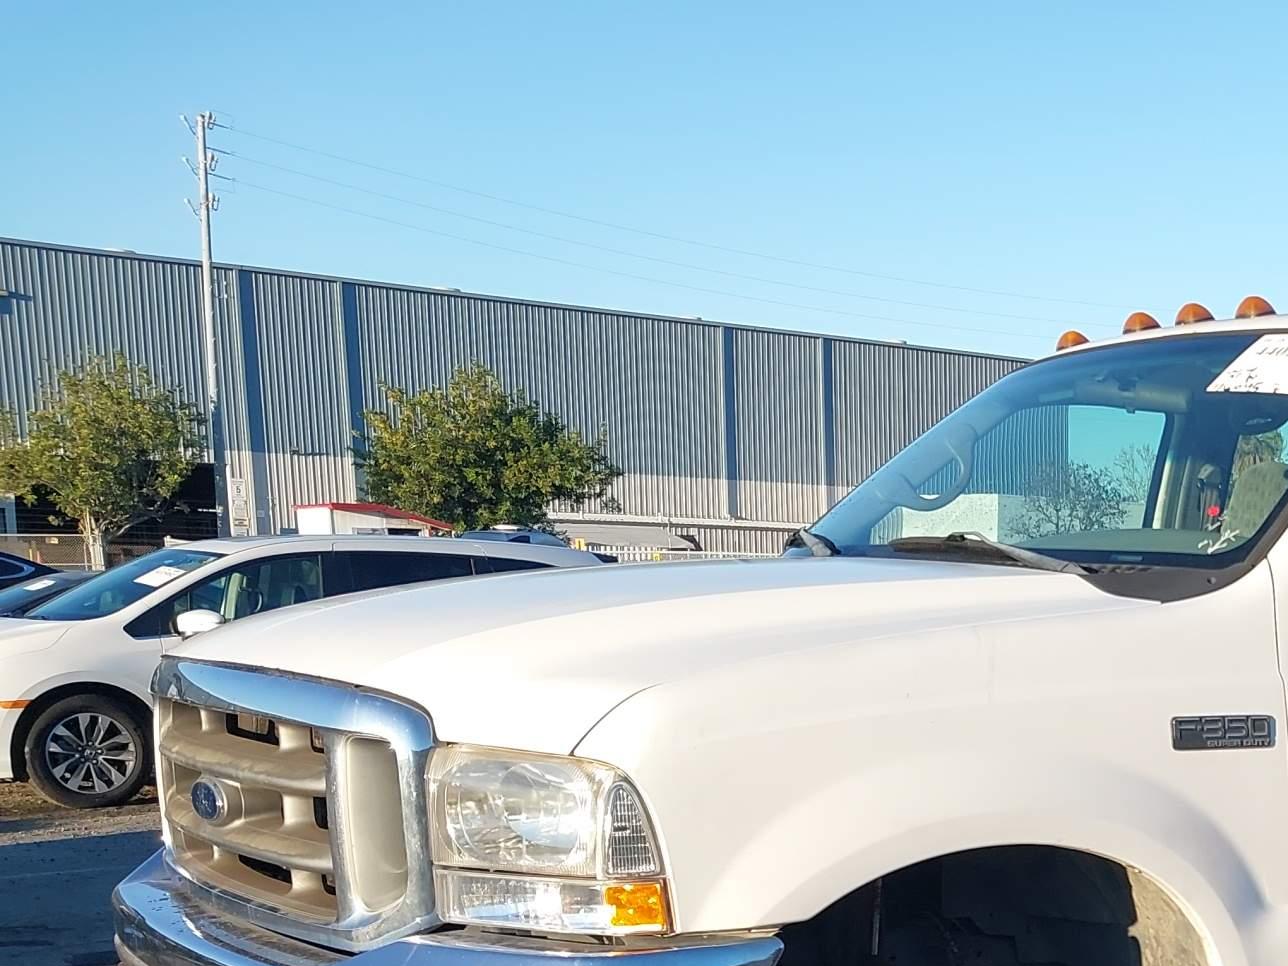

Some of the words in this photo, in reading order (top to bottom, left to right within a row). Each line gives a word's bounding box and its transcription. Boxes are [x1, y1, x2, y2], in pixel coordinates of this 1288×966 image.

[1173, 716, 1269, 741] F-350
[1207, 739, 1241, 747] SUPER
[1243, 737, 1269, 746] DUTY
